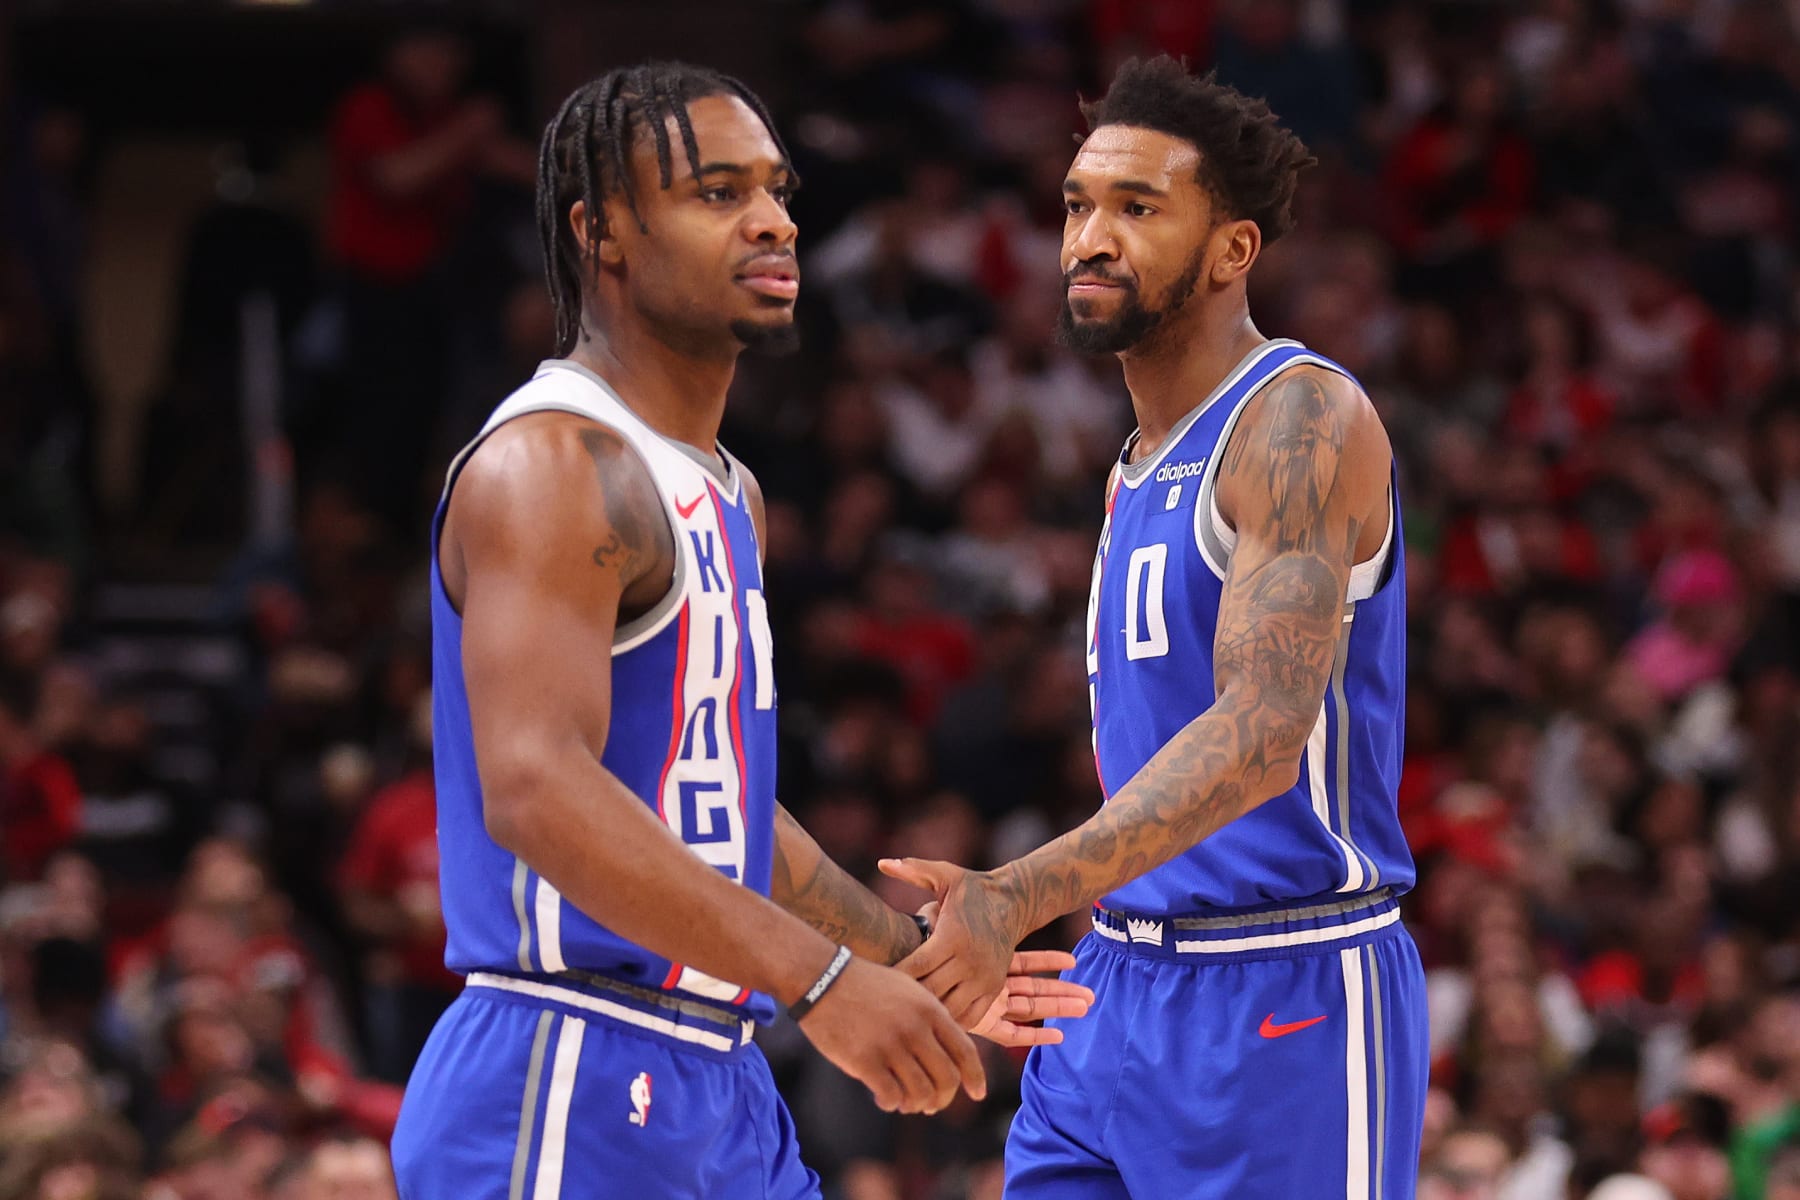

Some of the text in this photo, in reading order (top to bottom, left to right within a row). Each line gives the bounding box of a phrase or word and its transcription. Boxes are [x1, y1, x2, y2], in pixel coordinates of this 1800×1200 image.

[1156, 457, 1206, 484] dialpad
[746, 588, 776, 710] 1
[1126, 543, 1169, 661] 0
[678, 530, 739, 879] KING
